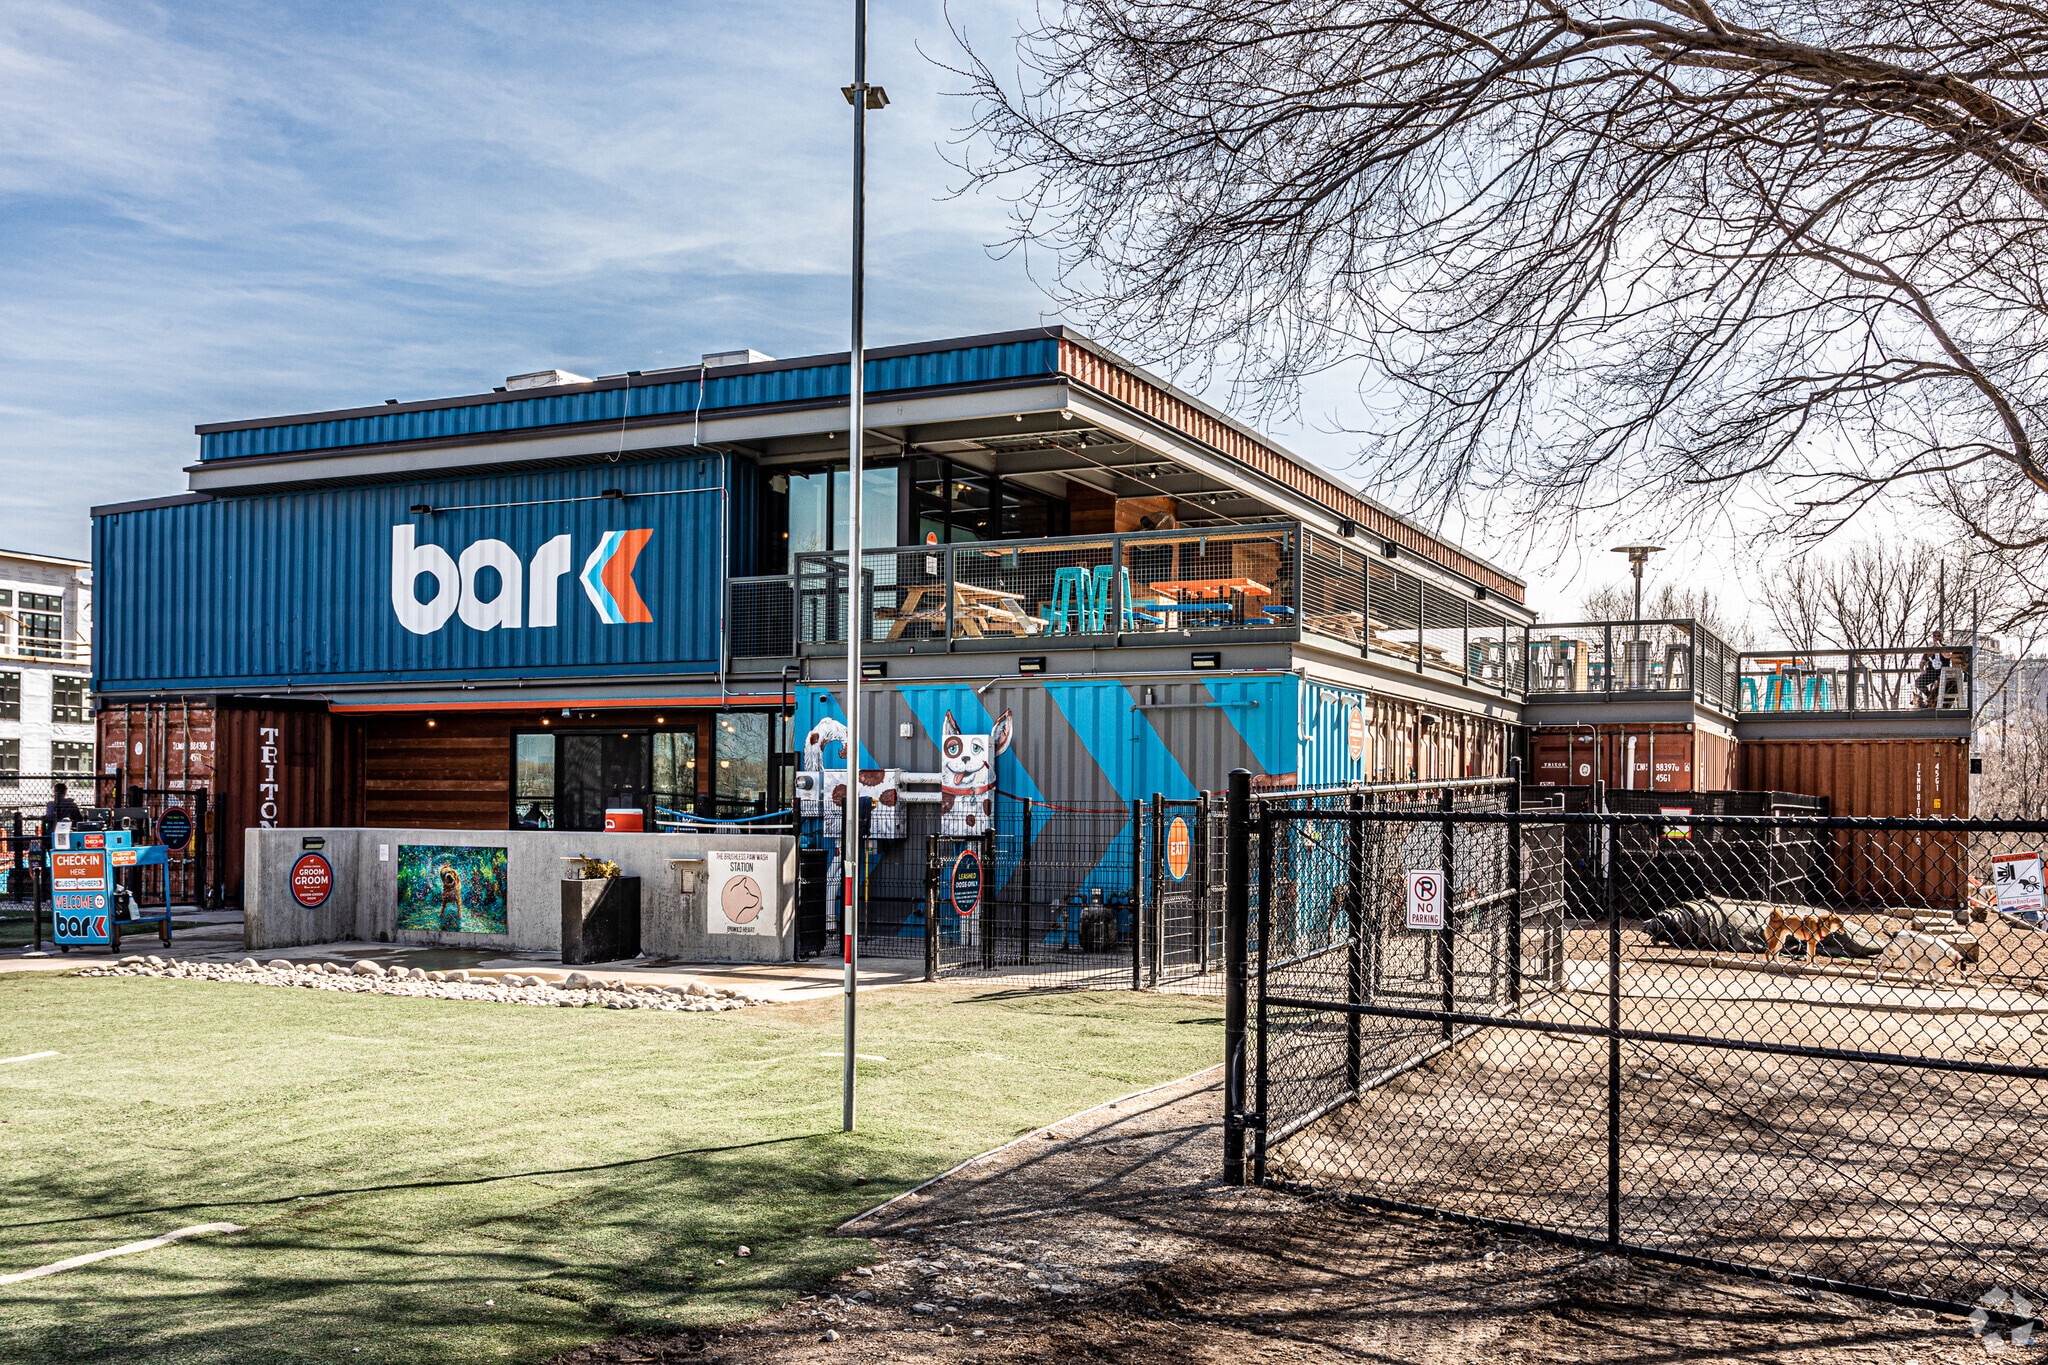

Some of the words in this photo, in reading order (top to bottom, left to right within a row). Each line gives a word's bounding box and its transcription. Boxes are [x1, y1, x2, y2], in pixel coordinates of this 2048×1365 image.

[1655, 773, 1671, 782] 45G1
[1170, 841, 1187, 856] EXIT
[56, 855, 100, 866] CHECK-IN
[716, 852, 724, 860] THE
[724, 852, 746, 860] BRUSHLESS
[755, 853, 769, 861] WASH
[729, 861, 754, 872] STATION
[70, 868, 86, 876] HERE
[958, 872, 977, 880] LEASHED
[294, 876, 328, 885] GROOM
[54, 895, 93, 910] WELCOME
[1417, 903, 1434, 913] NO
[1411, 913, 1439, 923] PARKING
